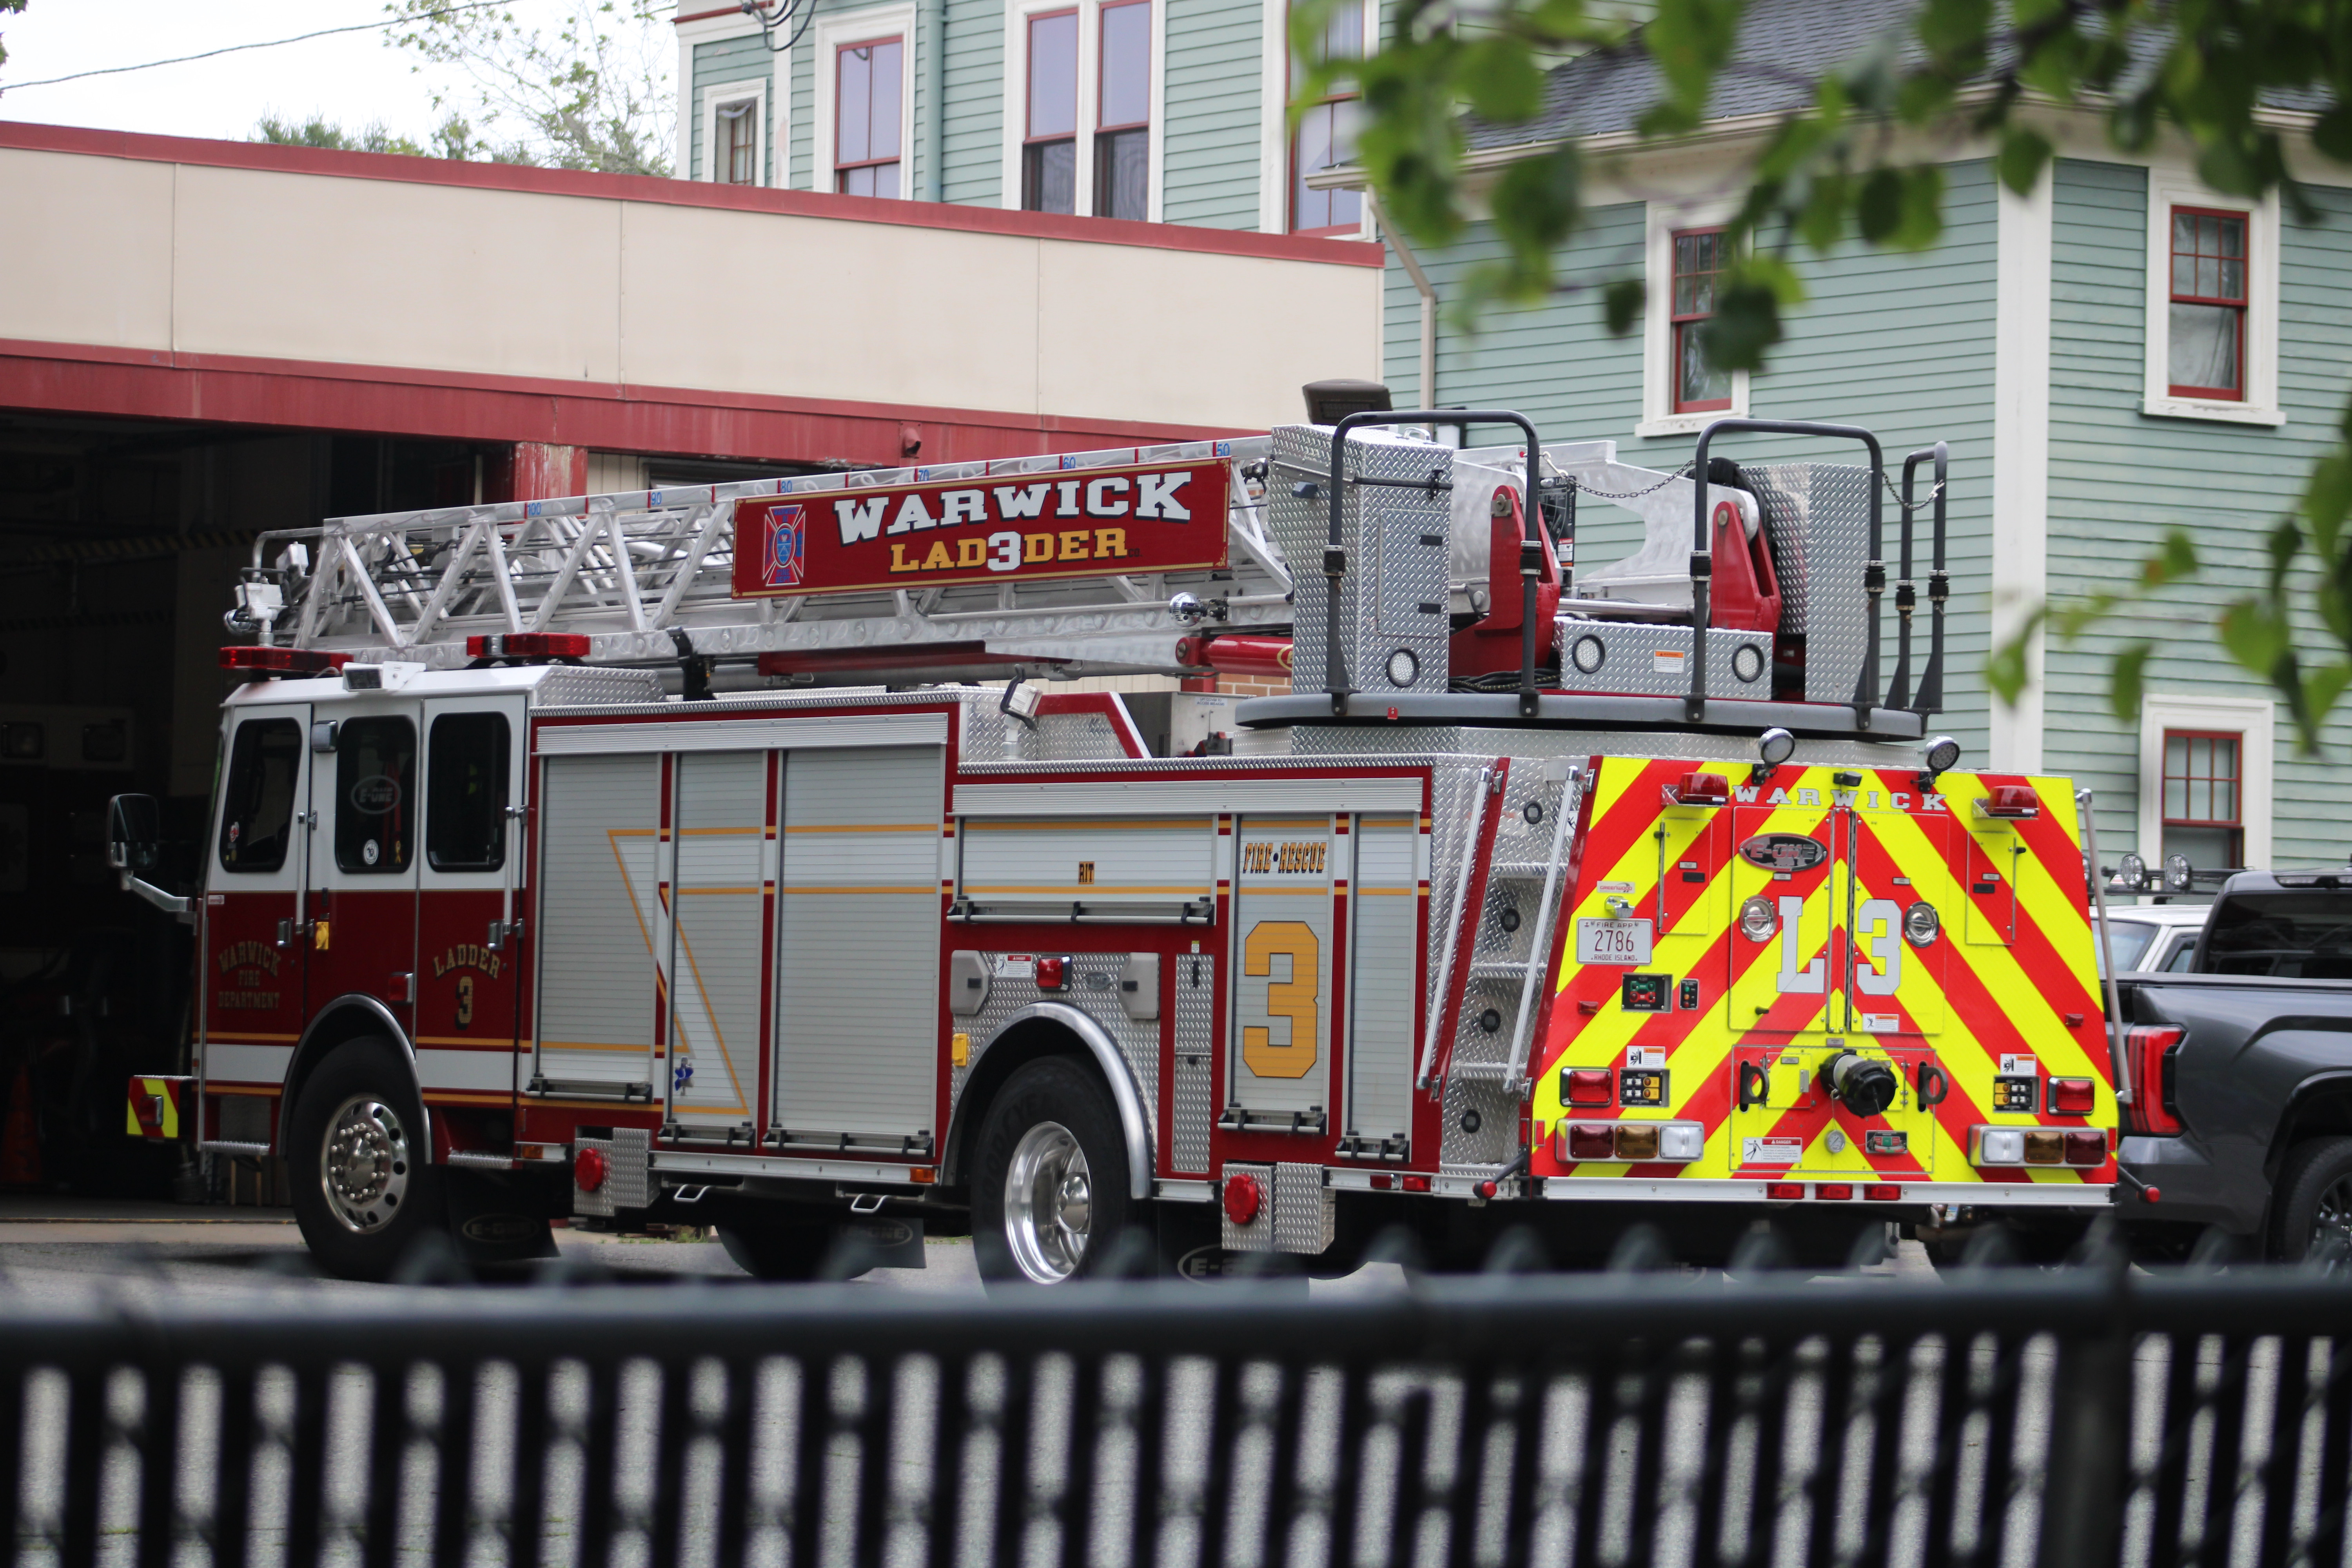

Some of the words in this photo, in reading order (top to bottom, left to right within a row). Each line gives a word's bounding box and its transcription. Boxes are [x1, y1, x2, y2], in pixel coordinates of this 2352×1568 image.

[1216, 443, 1230, 457] 50
[1063, 457, 1076, 469] 60
[918, 469, 930, 482] 70
[781, 480, 792, 493] 80
[651, 492, 662, 505] 90
[527, 502, 542, 516] 100
[834, 471, 1192, 545] WARWICK
[1129, 548, 1143, 557] CO.
[1733, 785, 1946, 811] WARWICK
[1750, 843, 1815, 859] E-ONE
[1079, 863, 1094, 882] RIT
[1595, 929, 1634, 951] 2786
[1777, 896, 1825, 993] L
[1857, 898, 1902, 995] 3
[218, 940, 282, 978] WARWICK
[432, 944, 501, 980] LADDER
[238, 969, 260, 987] FIRE
[218, 991, 280, 1009] DEPARTMENT
[455, 976, 474, 1030] 3
[1243, 920, 1319, 1078] 3
